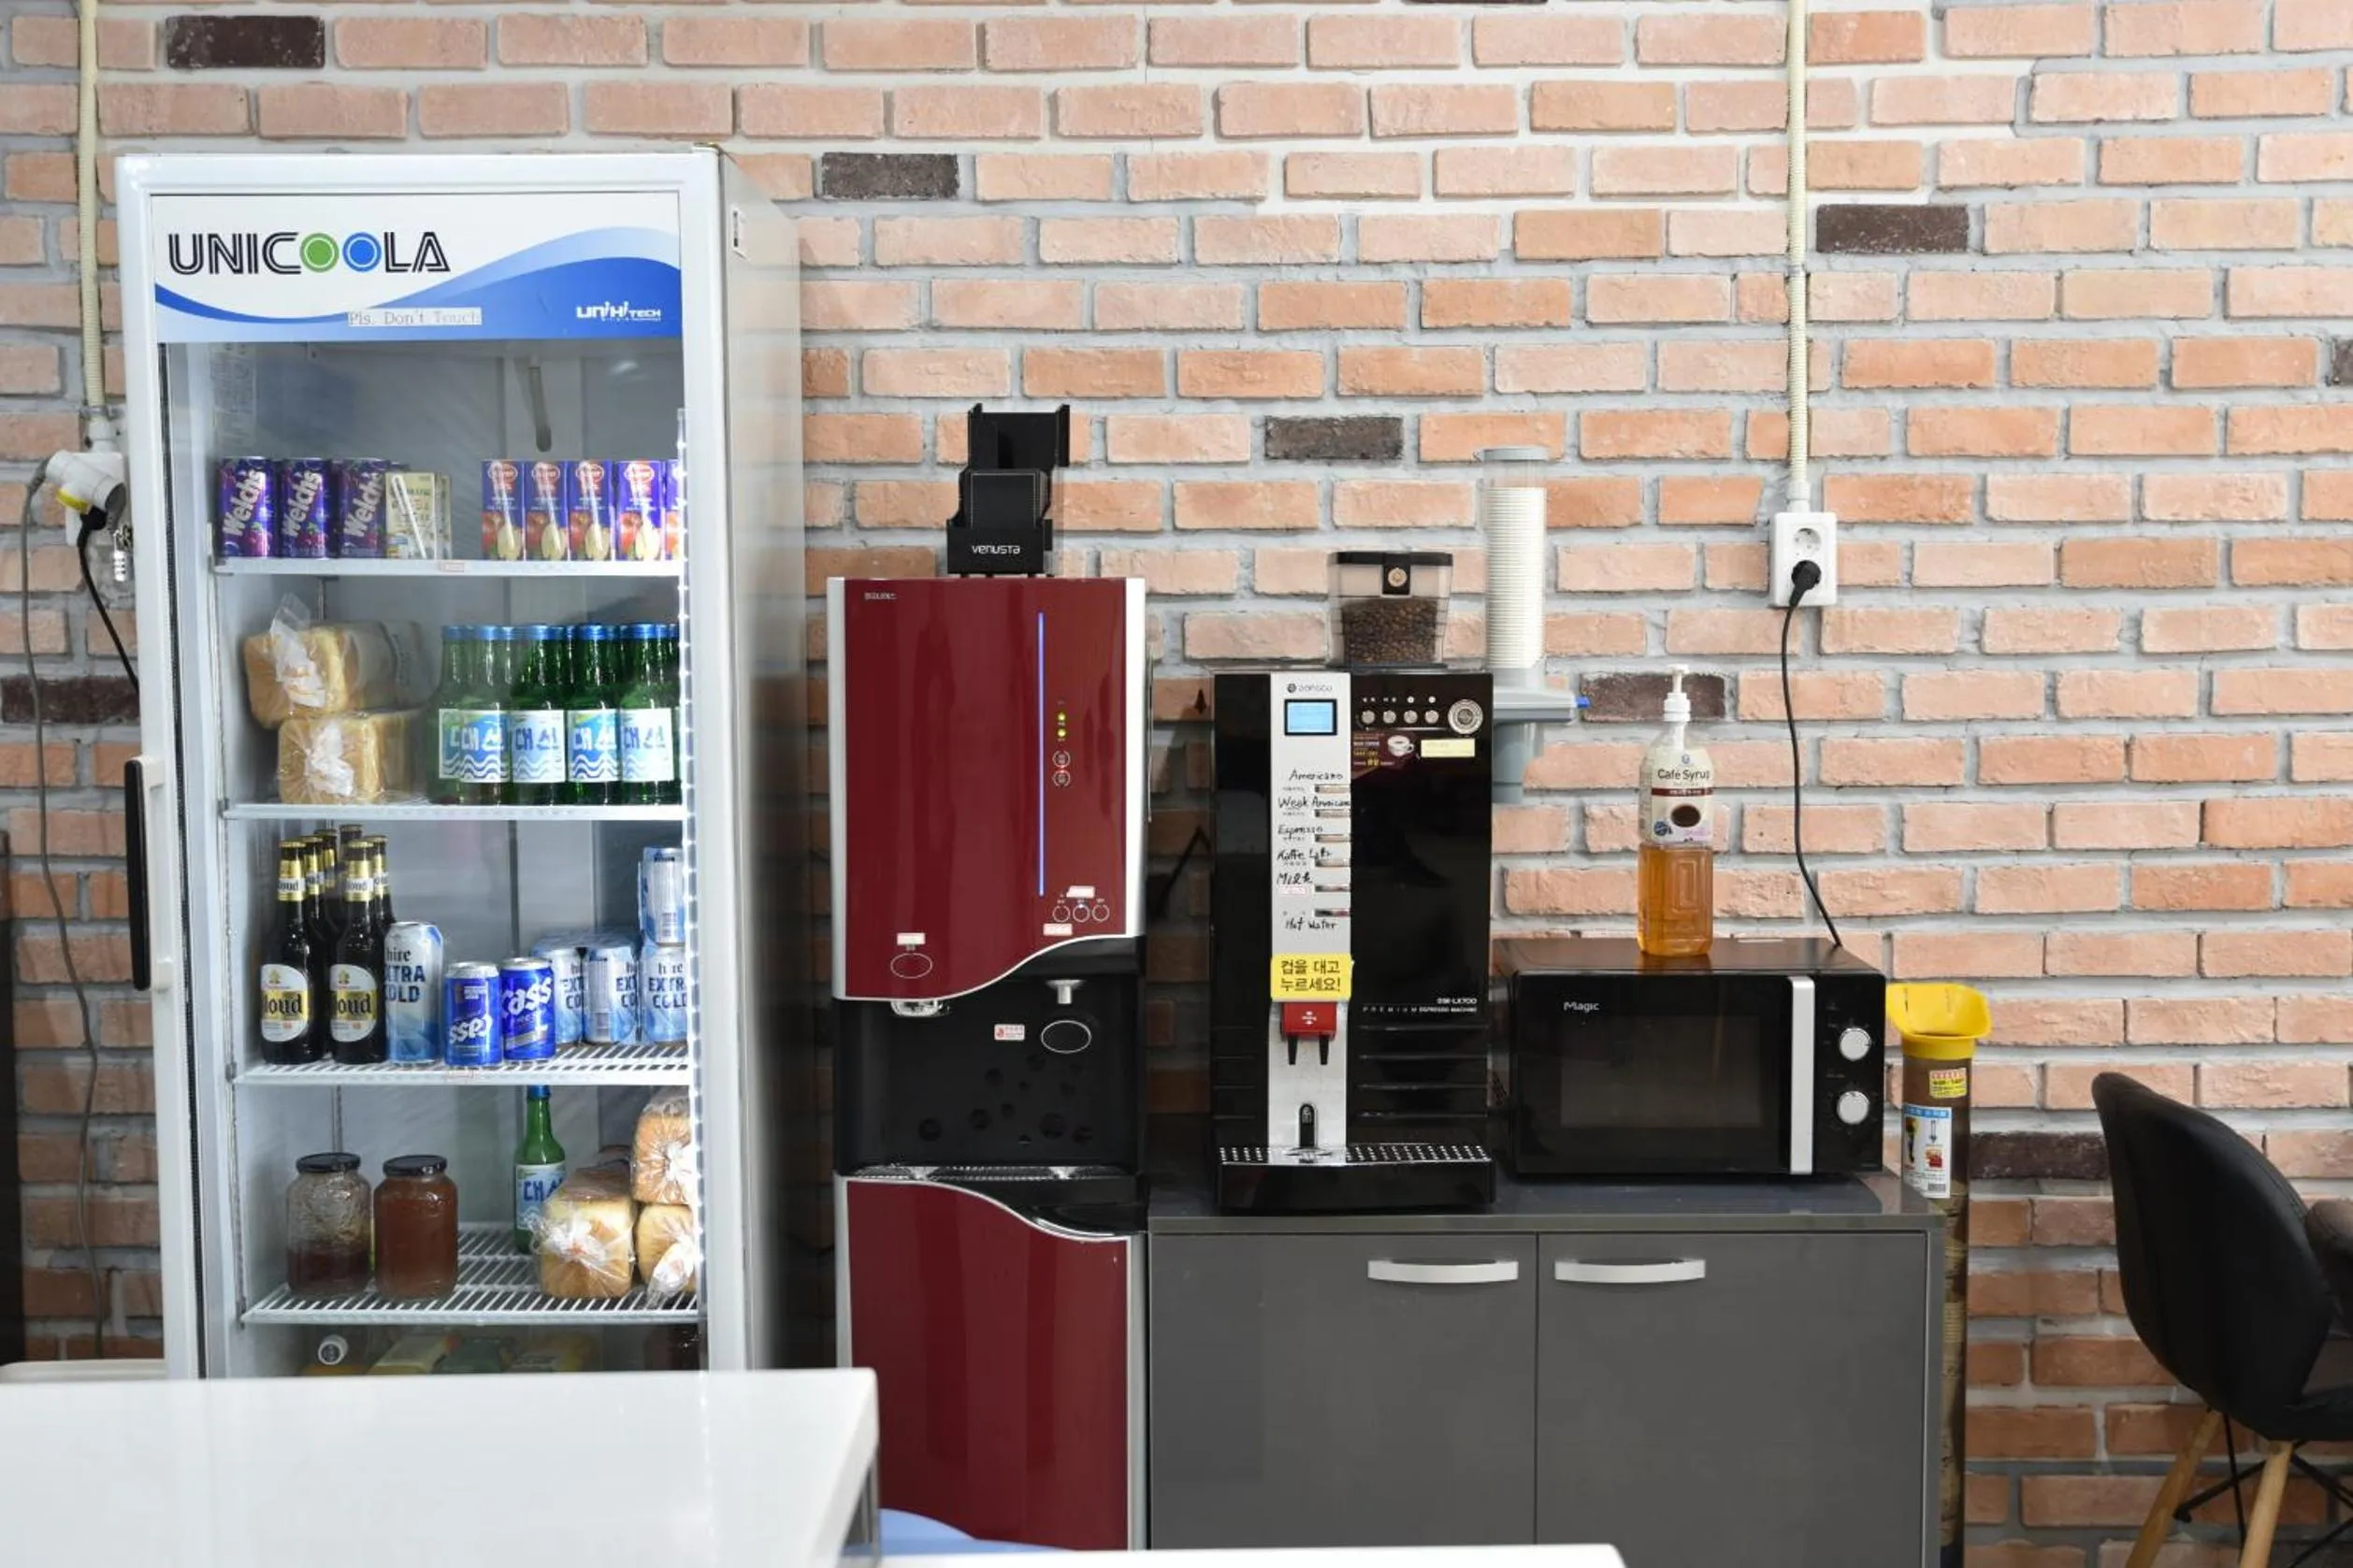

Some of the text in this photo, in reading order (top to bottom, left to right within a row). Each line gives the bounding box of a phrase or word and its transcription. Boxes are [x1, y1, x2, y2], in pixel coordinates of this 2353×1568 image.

[168, 231, 451, 275] UNICOOLA
[1281, 958, 1340, 974] 컵을 대고
[1280, 977, 1341, 992] 누르세요!
[387, 985, 420, 1002] OLD
[1564, 1001, 1599, 1013] Magic
